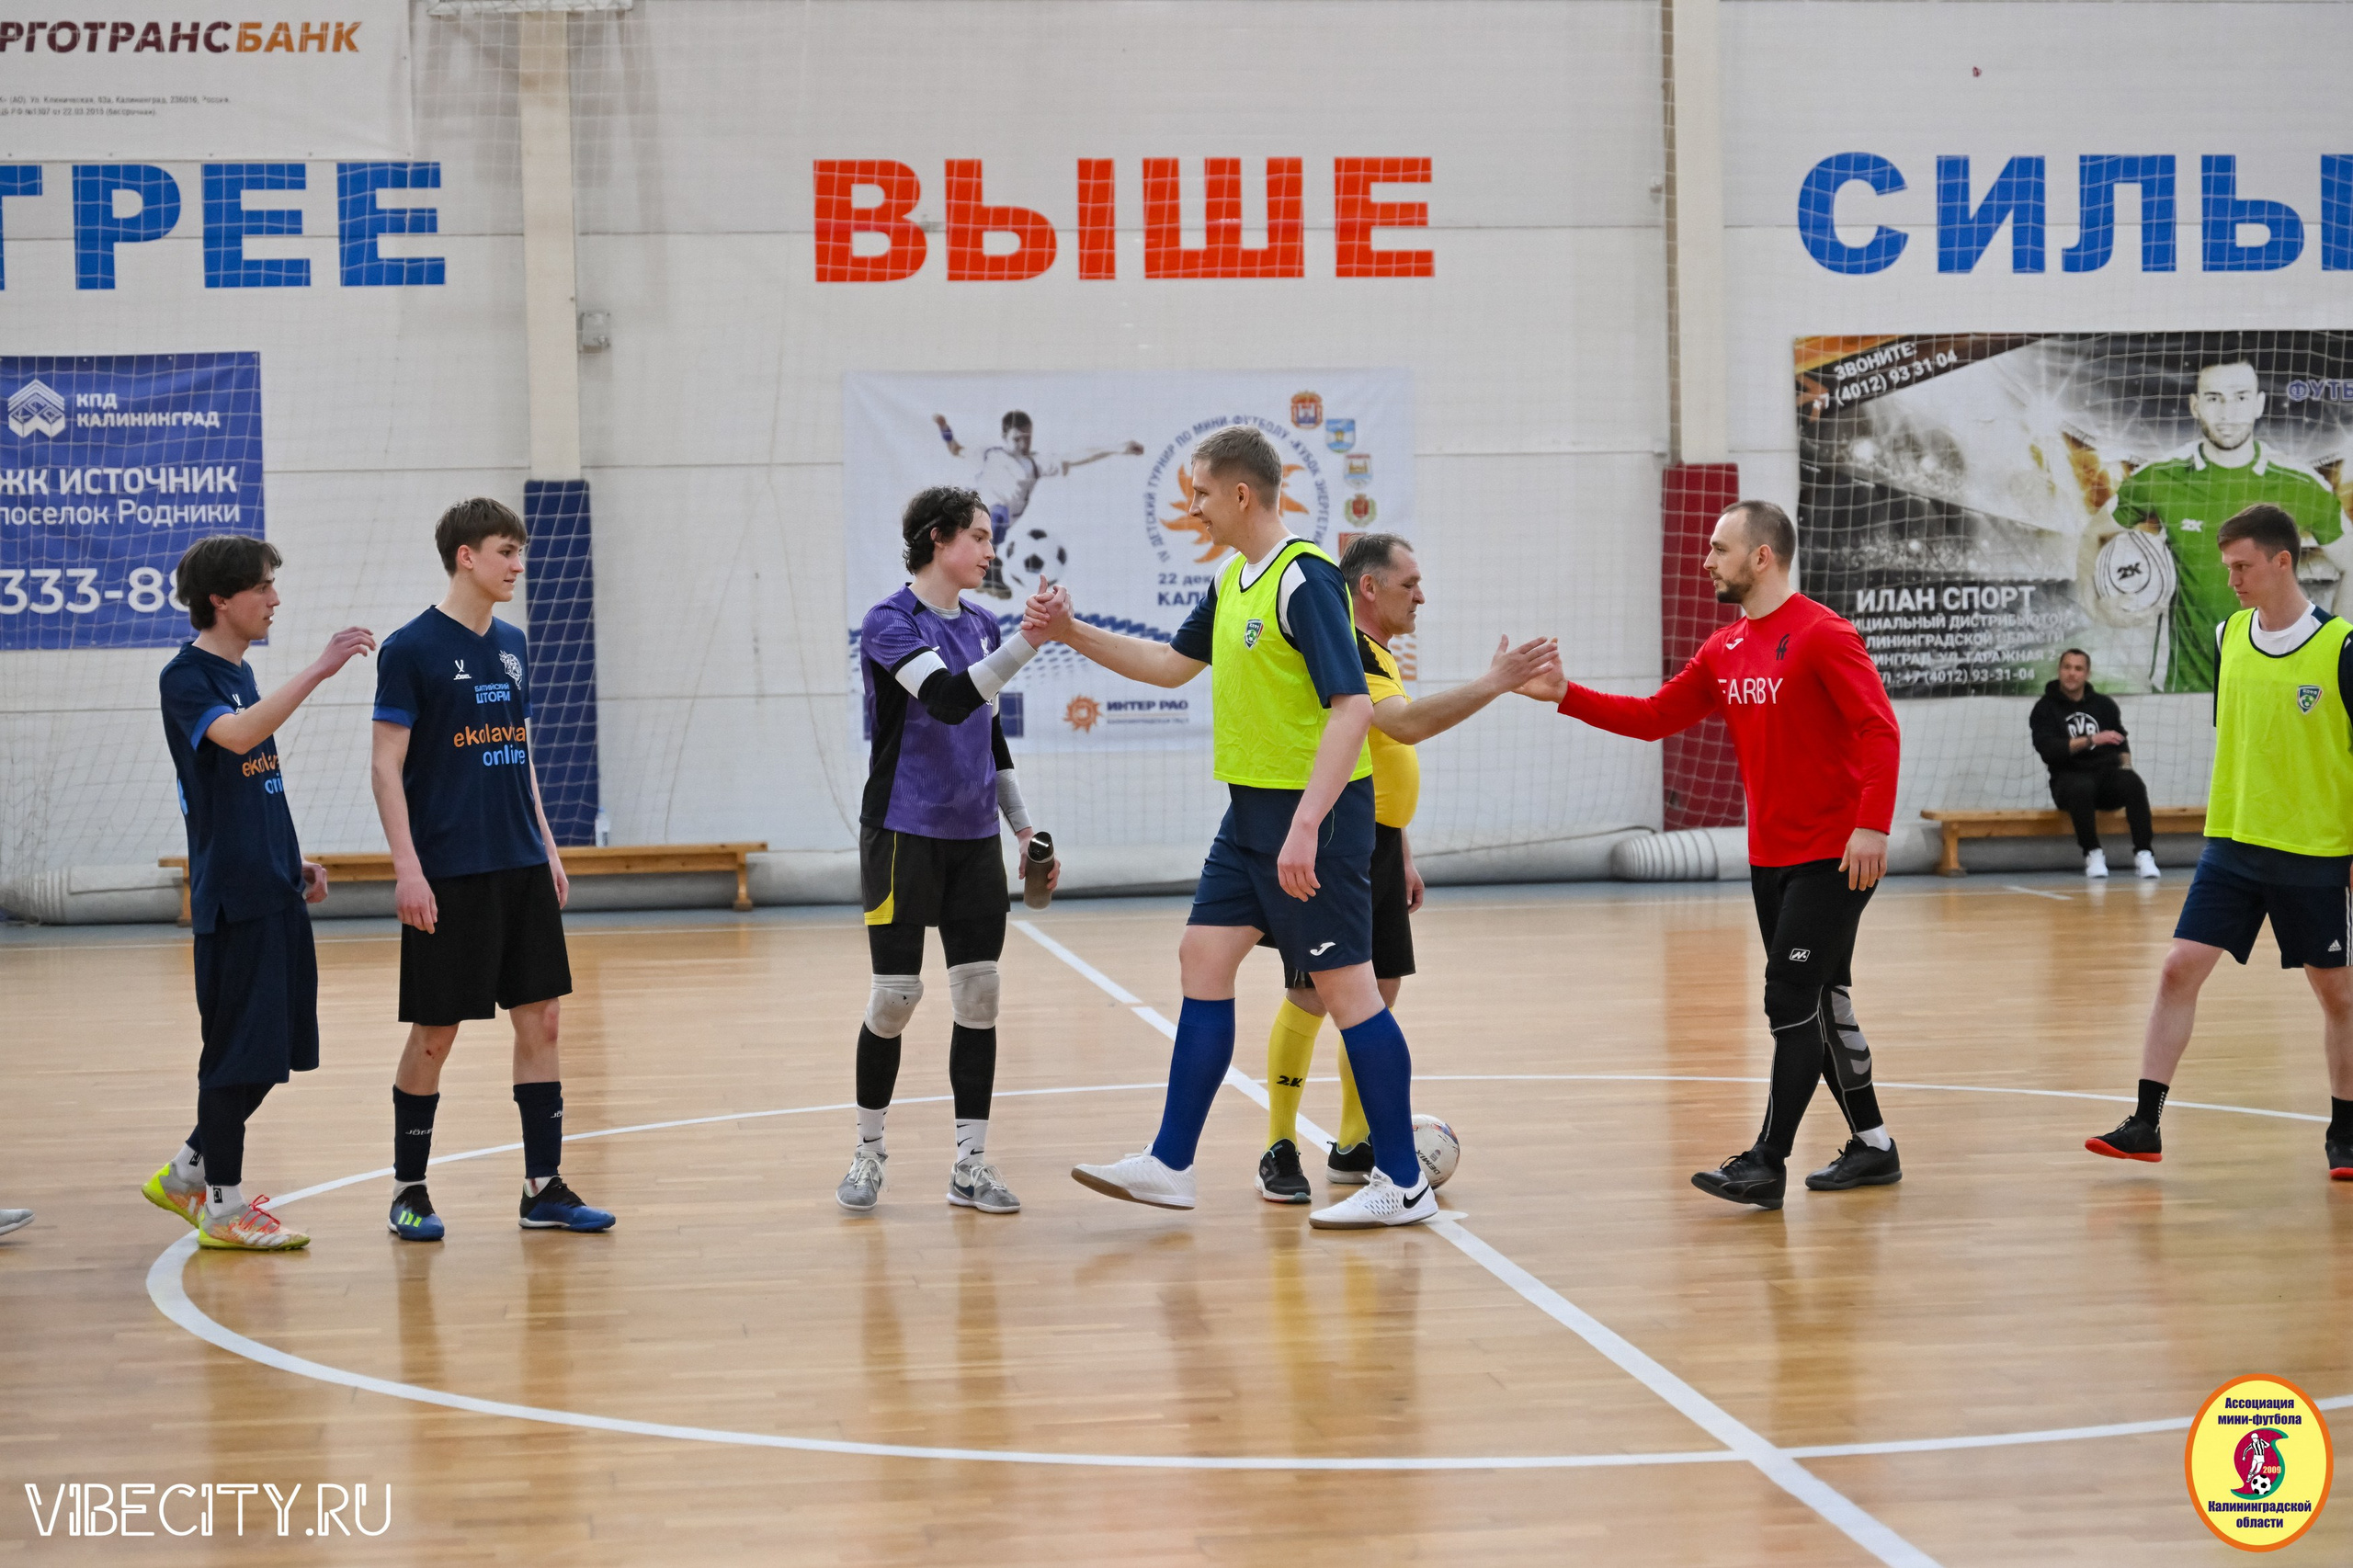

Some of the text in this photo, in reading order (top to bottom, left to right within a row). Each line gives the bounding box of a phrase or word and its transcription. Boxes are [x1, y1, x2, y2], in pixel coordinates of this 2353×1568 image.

[0, 20, 362, 53] РГОТРАНСБАНК
[813, 156, 1435, 282] ВЫШЕ
[1833, 341, 1918, 381] ЗВОНИТЕ:
[1835, 373, 1888, 407] (4012)
[1889, 365, 1911, 385] 93
[1912, 359, 1934, 377] 31
[1936, 347, 1959, 369] 04
[76, 392, 118, 410] КПД
[76, 411, 221, 429] КАЛИНИНГРАД
[1147, 443, 1176, 488] ТУРНИР
[1176, 430, 1192, 448] ПО
[0, 466, 237, 495] ЖК ИСТОЧНИК
[118, 499, 241, 528] Родники
[1158, 573, 1177, 585] 22
[1856, 585, 2037, 613] ИЛАН СПОРТ
[1972, 667, 2035, 682] 93-31-04
[1107, 699, 1189, 711] ИНТЕР РАО
[1415, 1149, 1441, 1176] DEMIX
